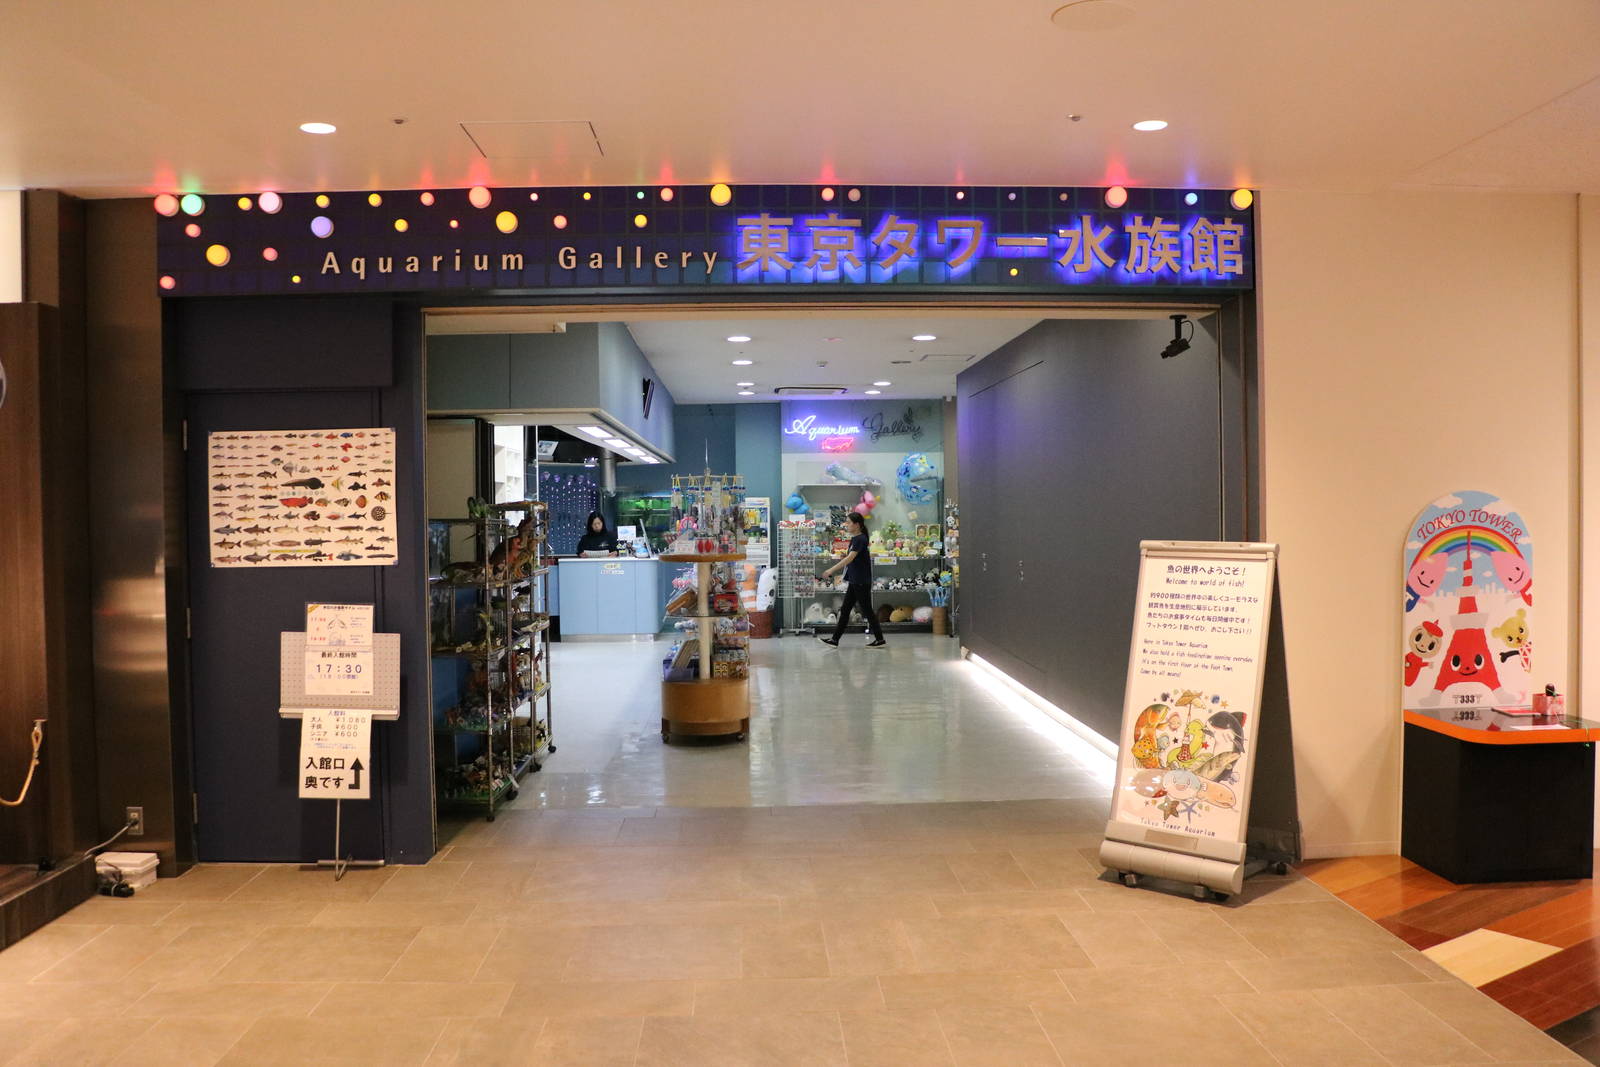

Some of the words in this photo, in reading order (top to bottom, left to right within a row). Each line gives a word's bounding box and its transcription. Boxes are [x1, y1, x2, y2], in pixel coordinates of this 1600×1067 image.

[736, 213, 1245, 276] 東京タワー水族館
[320, 249, 525, 280] Aquarium
[557, 244, 719, 275] Gallery
[784, 415, 860, 441] Aquarium
[1416, 509, 1466, 540] TOKYO
[1468, 508, 1523, 545] TOWER
[1165, 577, 1187, 585] Welcome
[316, 663, 362, 673] 17:30
[305, 756, 345, 770] 入館口
[304, 775, 344, 789] 奥です
[1140, 817, 1159, 827] Tokyo
[1162, 821, 1181, 831] Tower
[1184, 825, 1216, 837] Aquarium
